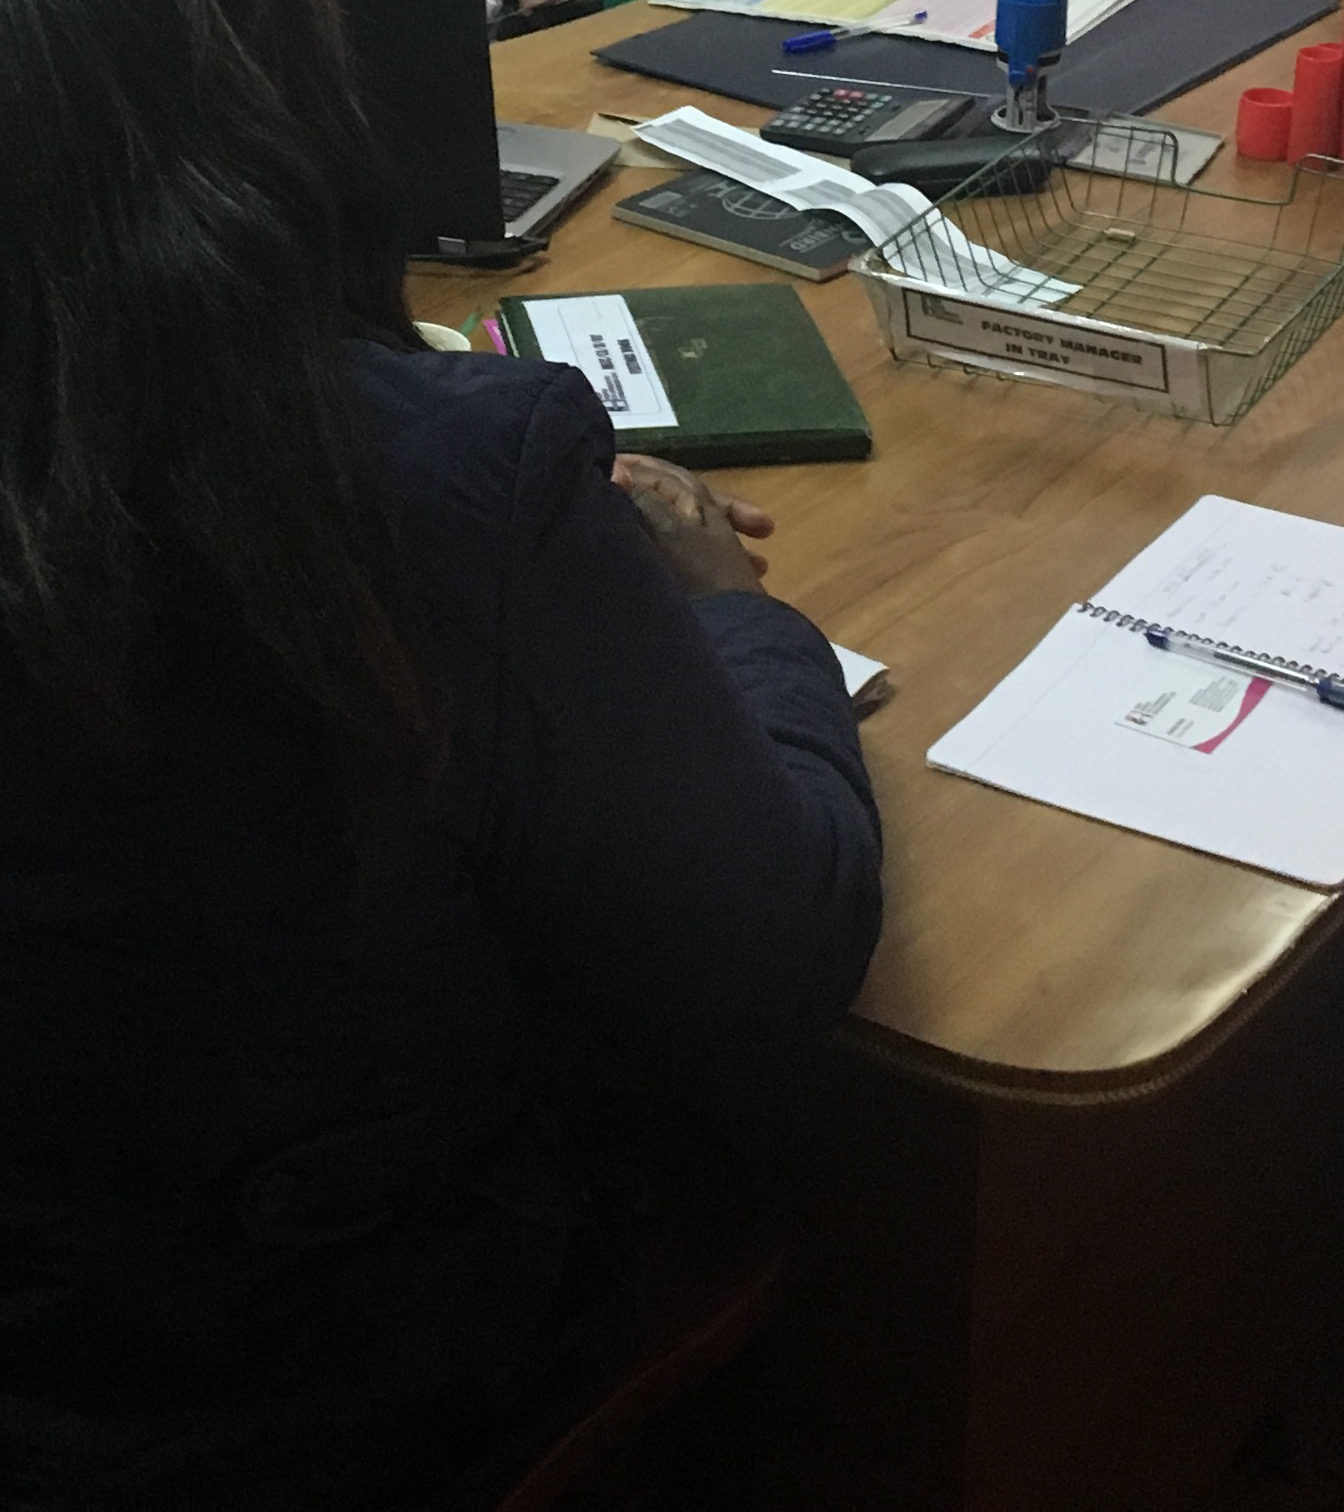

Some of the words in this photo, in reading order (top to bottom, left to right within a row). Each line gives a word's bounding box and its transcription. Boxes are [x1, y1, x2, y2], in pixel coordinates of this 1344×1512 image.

[981, 320, 1054, 345] FACTORY
[1060, 338, 1143, 365] MANAGER
[1005, 343, 1023, 355] IN
[1028, 348, 1070, 365] TRAY
